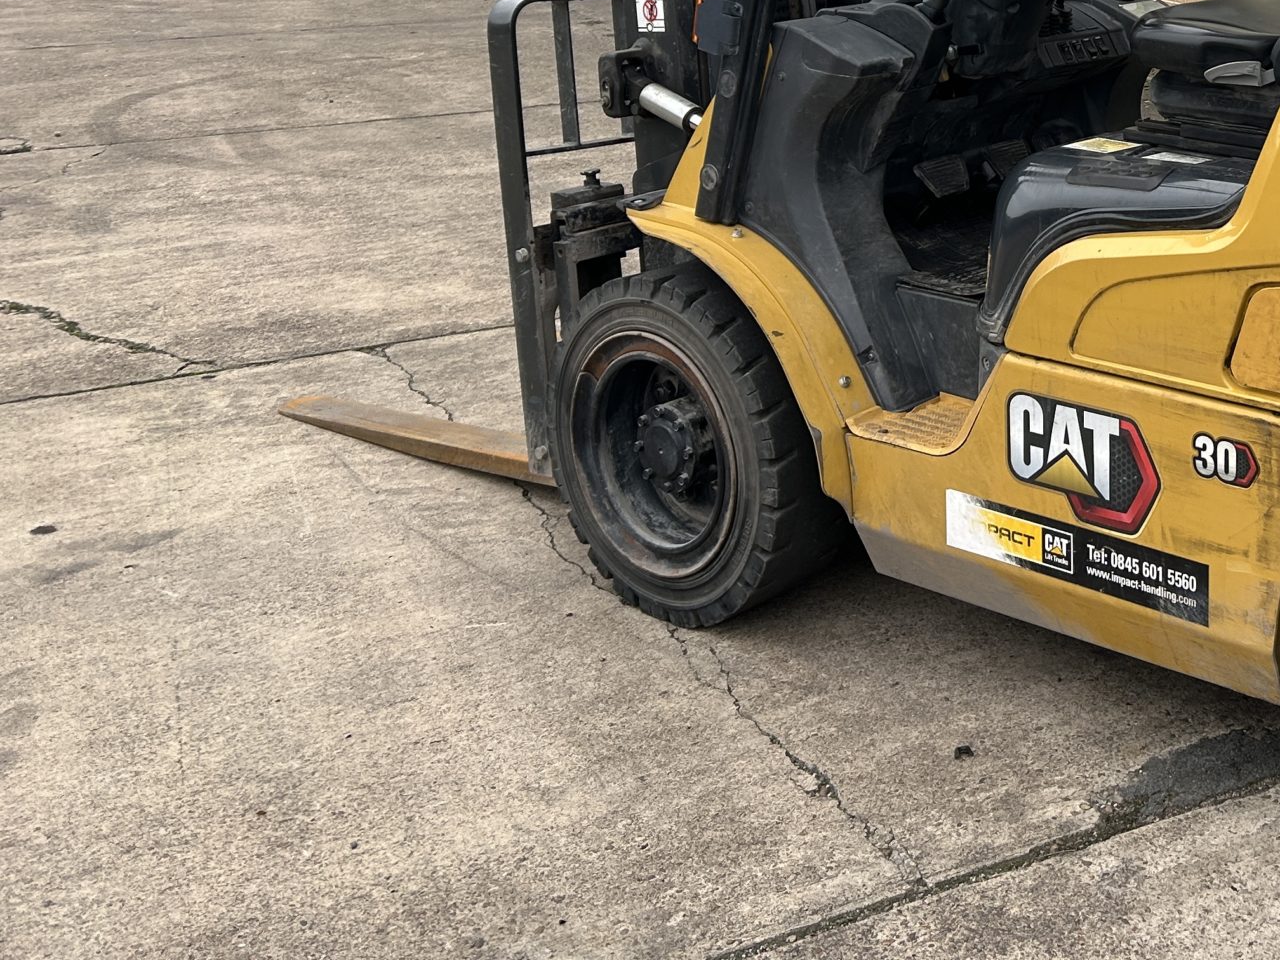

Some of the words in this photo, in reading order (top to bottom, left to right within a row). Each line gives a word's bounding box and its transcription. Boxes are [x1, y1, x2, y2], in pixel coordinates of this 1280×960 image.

[1009, 394, 1120, 501] CAT
[1194, 435, 1237, 482] 30
[1044, 533, 1069, 557] CAT
[1086, 543, 1108, 565] Tel:
[1110, 551, 1140, 574] 0845
[1142, 561, 1163, 582] 601
[1167, 568, 1197, 592] 5560
[1086, 565, 1197, 607] www.impact-handling.com
